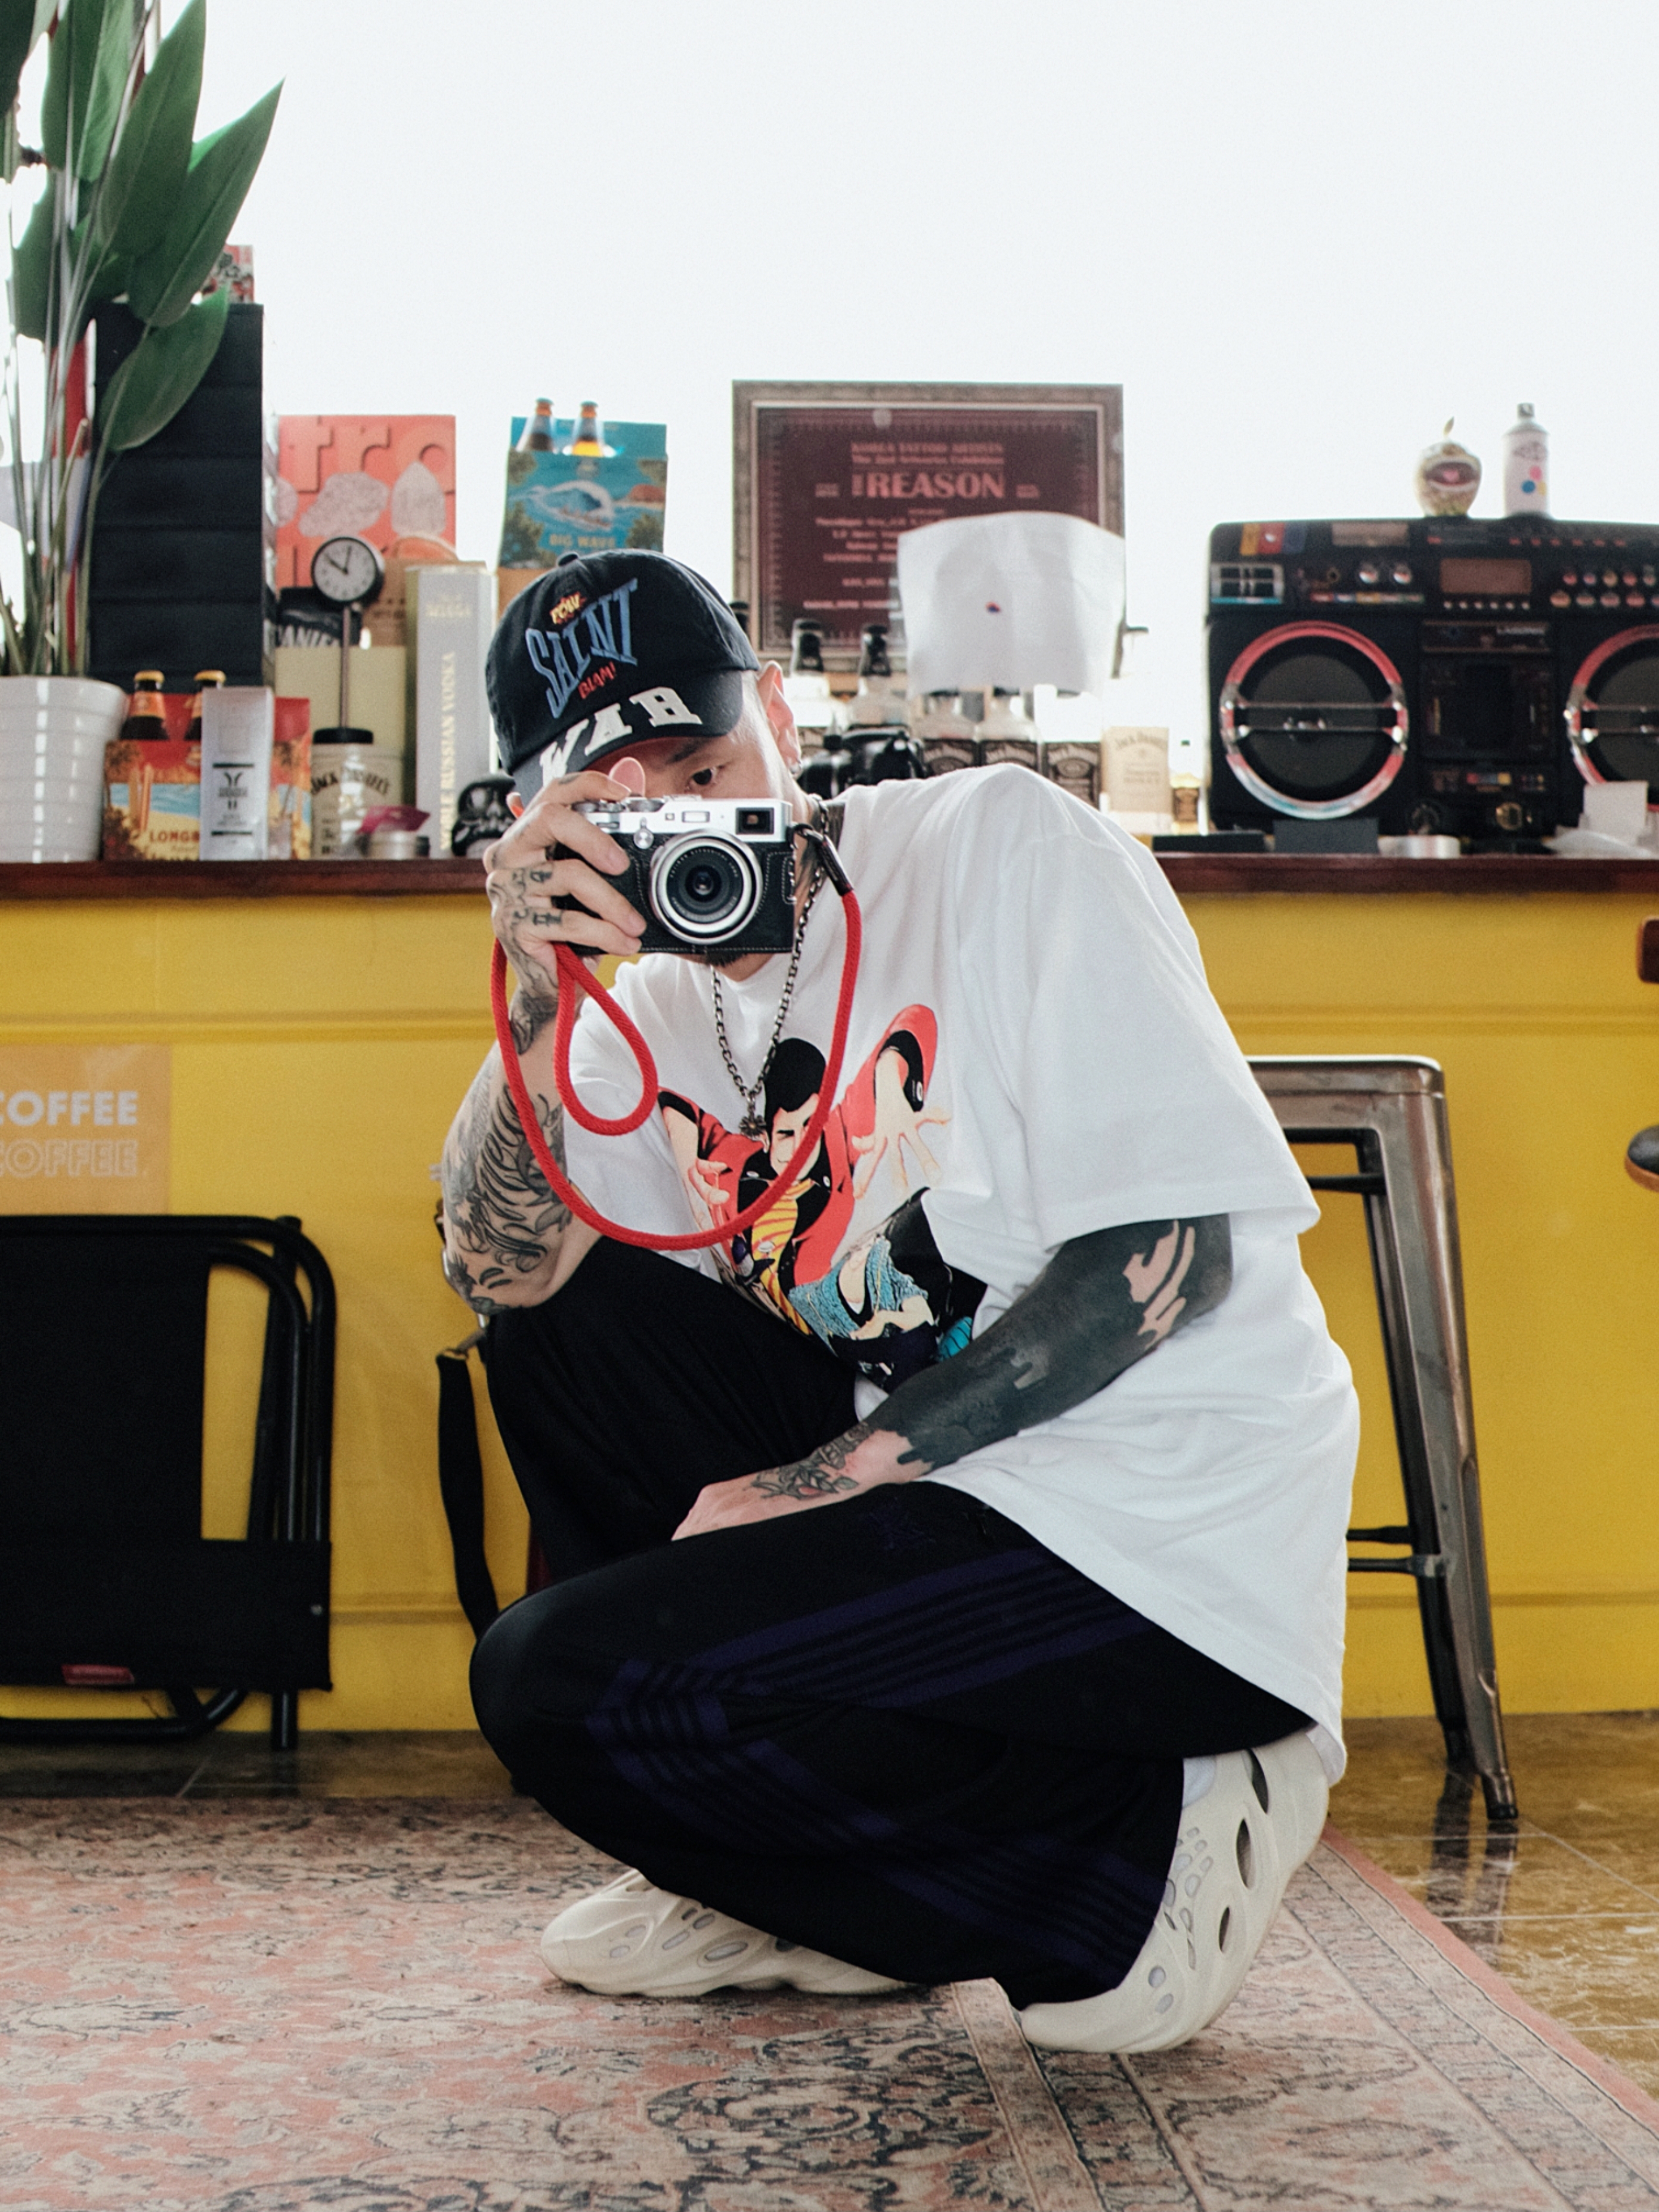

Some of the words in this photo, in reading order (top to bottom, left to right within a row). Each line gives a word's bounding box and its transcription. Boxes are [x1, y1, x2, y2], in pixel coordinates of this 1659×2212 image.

[866, 472, 1005, 499] REASON
[525, 577, 638, 718] SAINT
[0, 1090, 138, 1126] OFFEE
[0, 1138, 138, 1178] OFFEE
